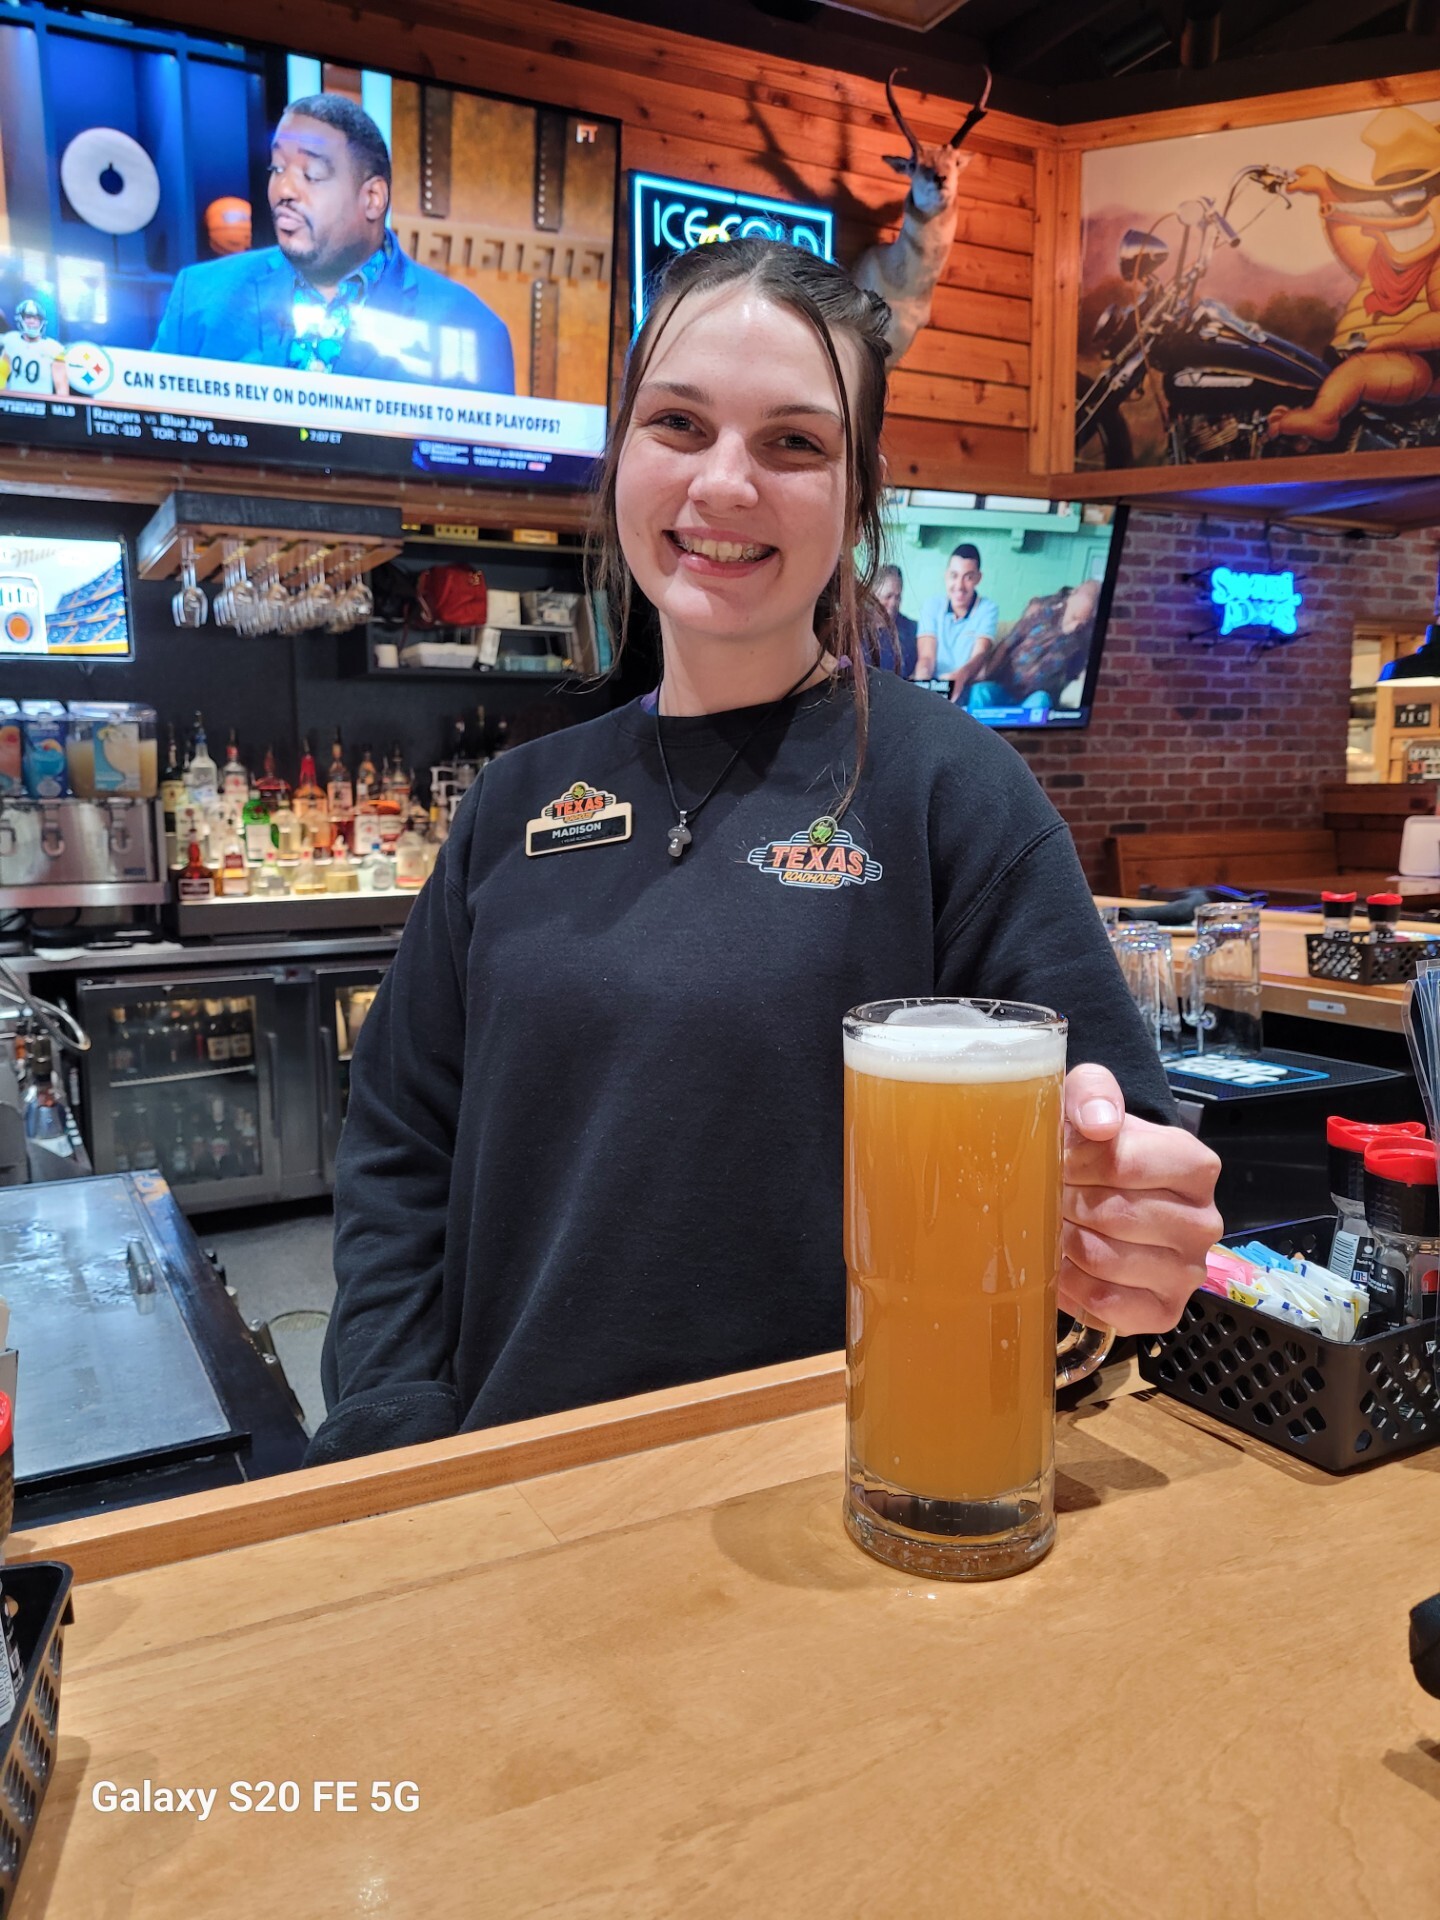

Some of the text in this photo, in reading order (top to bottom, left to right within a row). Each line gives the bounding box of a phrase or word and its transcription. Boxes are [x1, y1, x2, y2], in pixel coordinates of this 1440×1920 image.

[576, 124, 598, 144] FT
[653, 198, 821, 256] ICE CD
[123, 370, 561, 435] CAN STEELERS RELY ON DOMINANT DEFENSE TO MAKE PLAYOFFS?
[93, 406, 141, 425] Rangers
[160, 413, 188, 428] Blue
[189, 418, 215, 433] Jays
[554, 796, 605, 817] TEXAS
[552, 822, 602, 839] MADISON
[771, 845, 864, 877] TEXAS
[783, 871, 842, 884] ROADHOUSE
